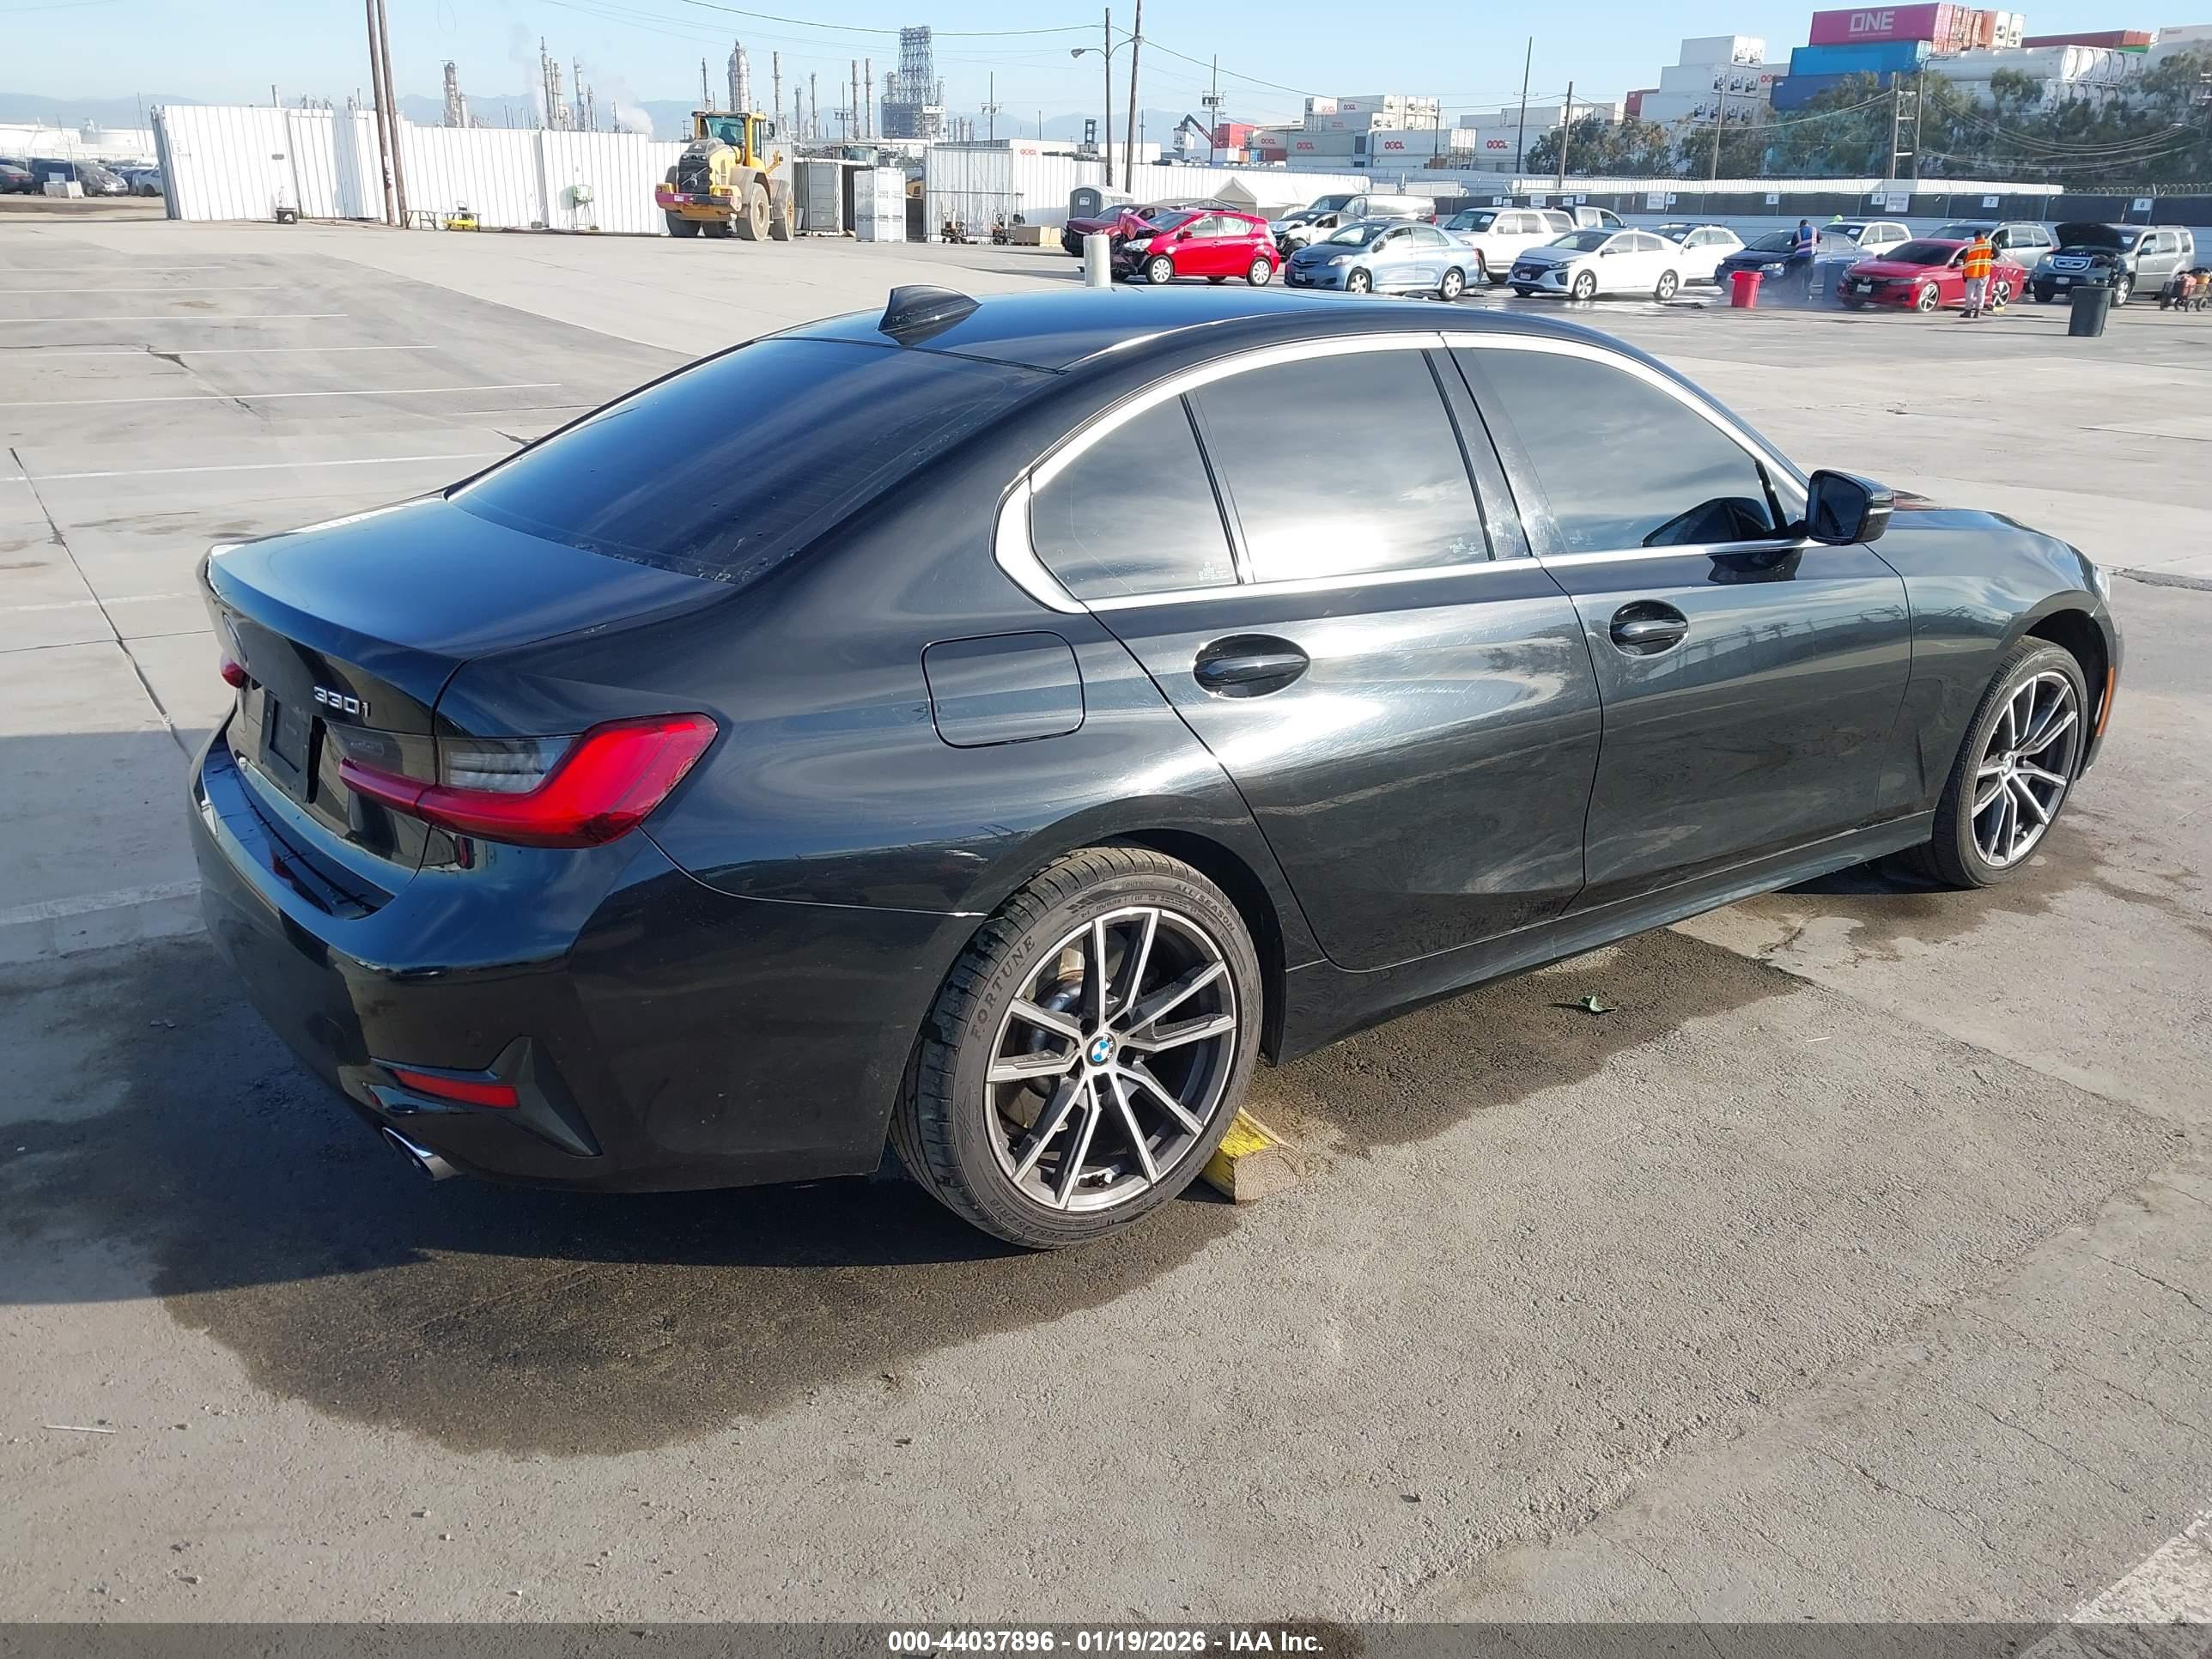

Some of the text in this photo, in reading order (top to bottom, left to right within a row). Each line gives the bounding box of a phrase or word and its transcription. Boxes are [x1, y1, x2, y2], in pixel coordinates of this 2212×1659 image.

[1849, 11, 1895, 33] ONE
[1297, 142, 1315, 150] OOCL
[1384, 140, 1405, 150] OOCL
[1486, 139, 1508, 149] OOCL
[313, 686, 370, 718] 330i
[970, 935, 1036, 1042] FORTUNE
